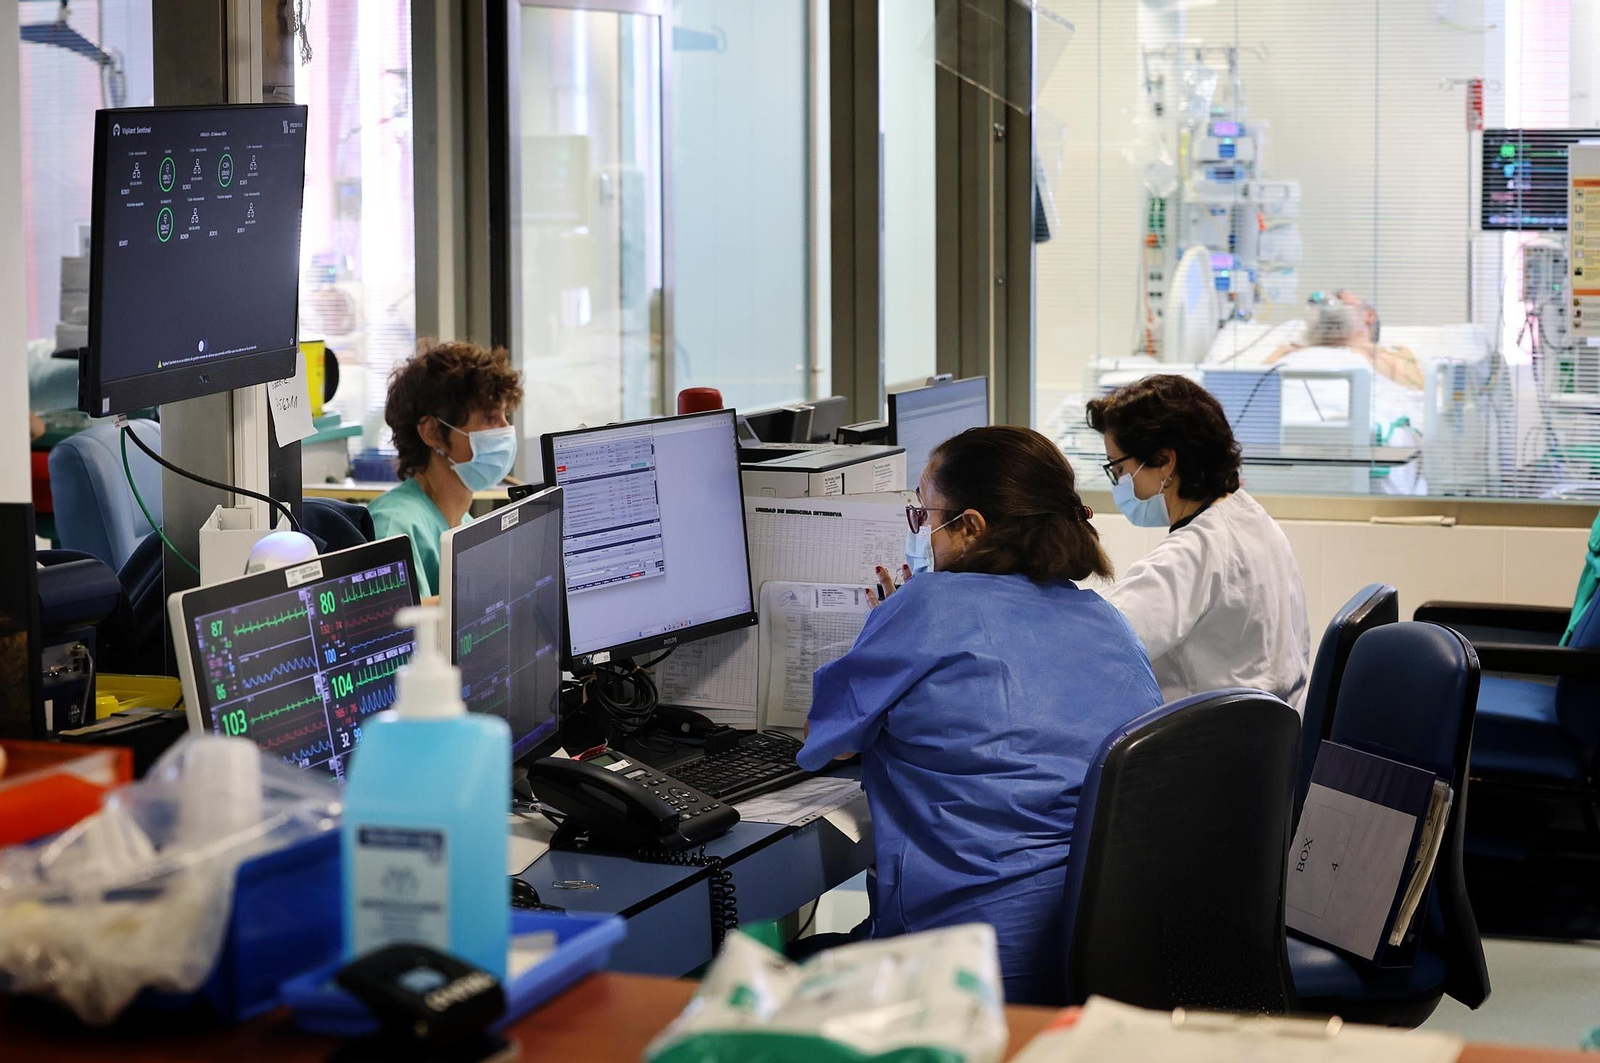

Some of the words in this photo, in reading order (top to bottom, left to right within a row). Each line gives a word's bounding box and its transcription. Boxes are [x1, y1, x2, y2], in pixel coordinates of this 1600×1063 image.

[122, 127, 136, 135] Vigilant
[320, 591, 336, 615] 80
[211, 620, 223, 637] 87
[324, 648, 337, 664] 100
[331, 672, 354, 699] 104
[222, 709, 247, 738] 103
[340, 732, 351, 748] 32
[1296, 837, 1313, 872] BOX
[1331, 862, 1339, 871] 4
